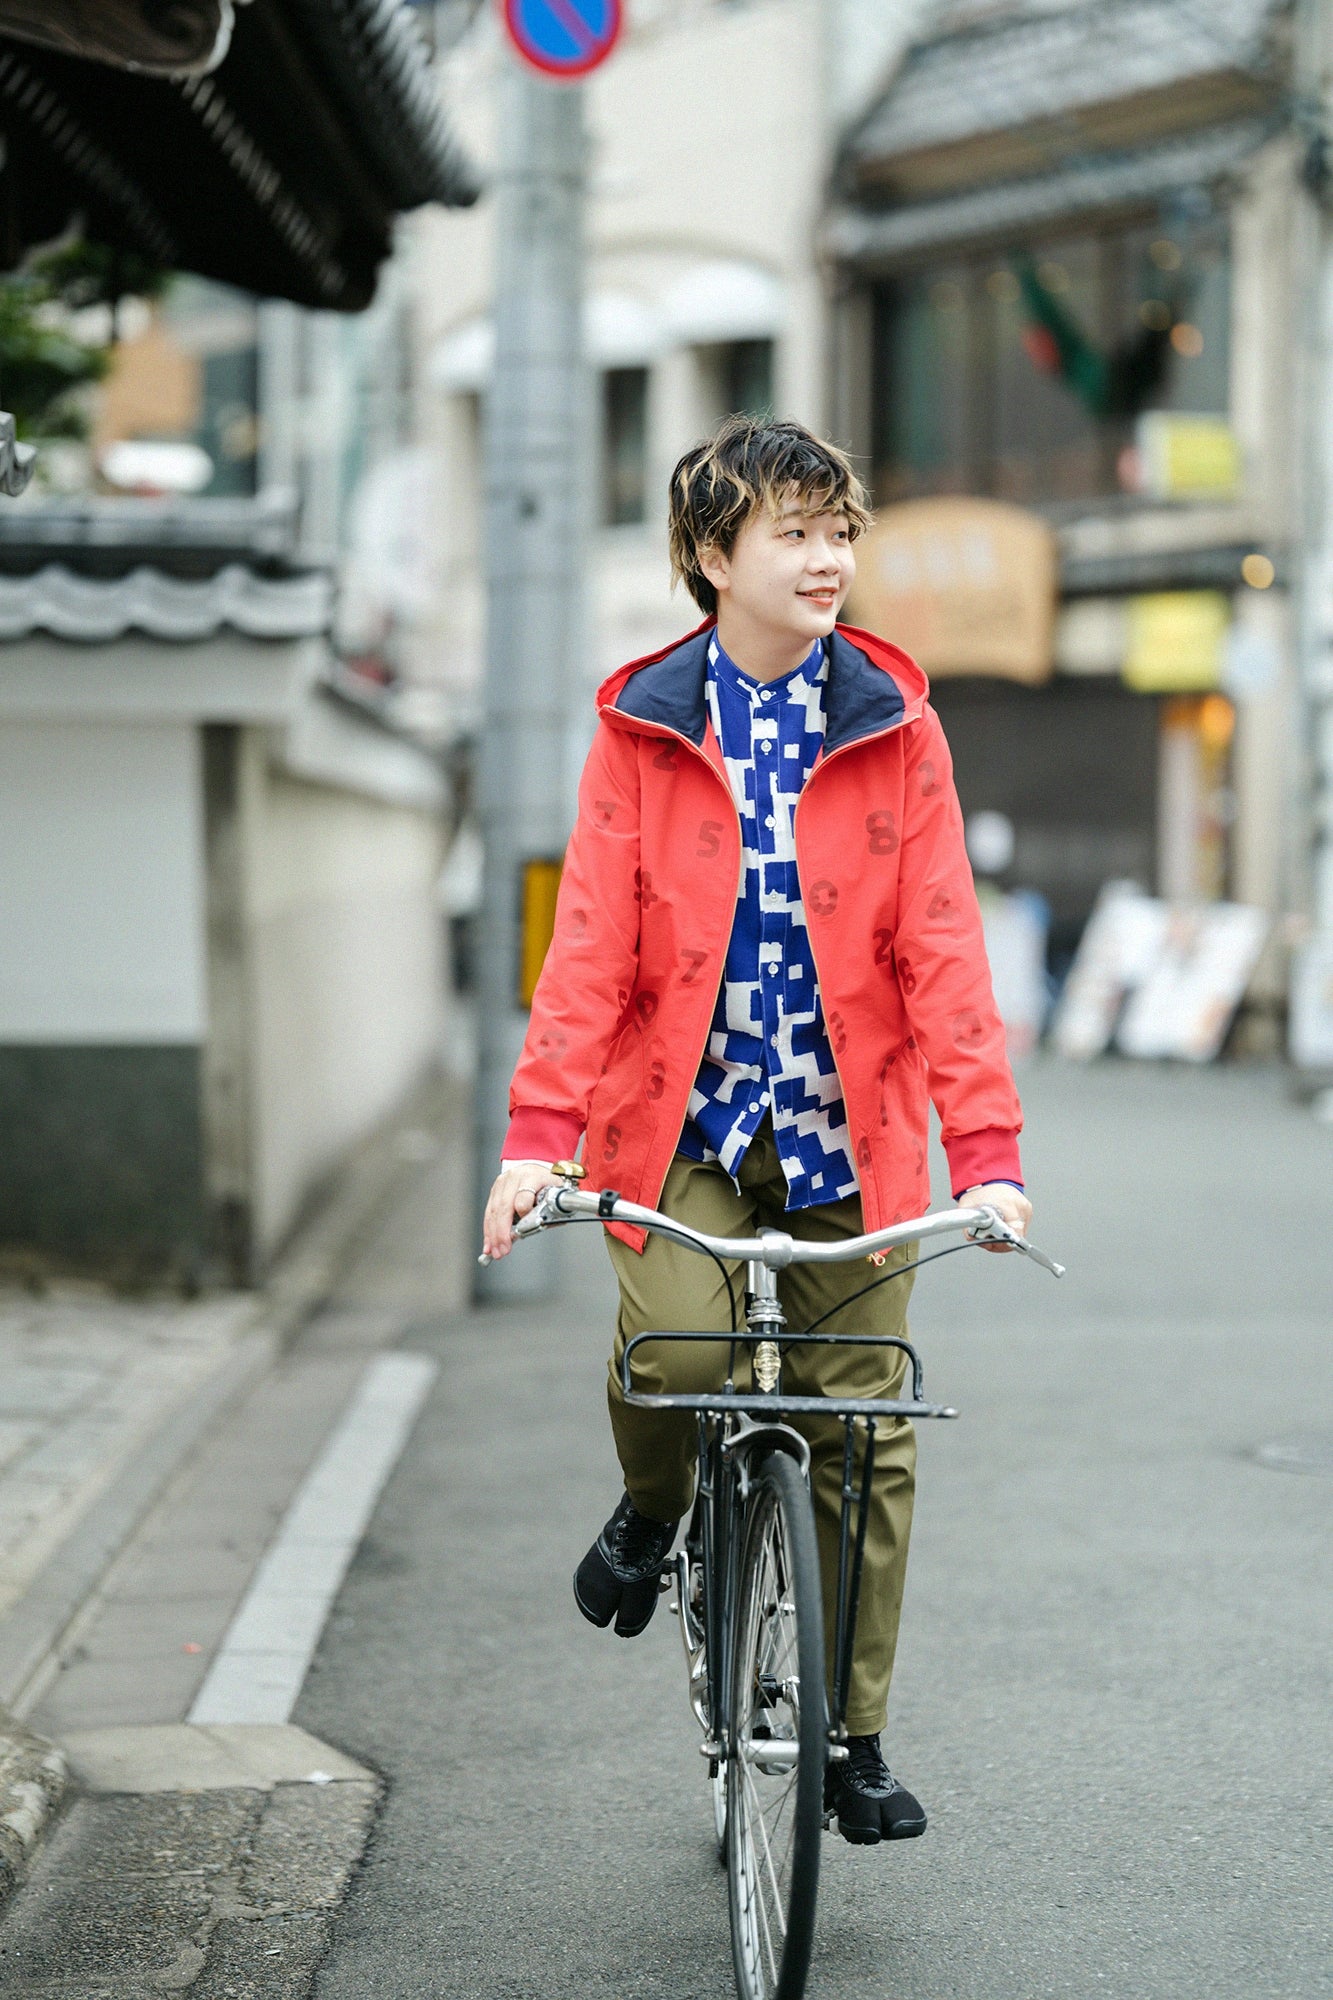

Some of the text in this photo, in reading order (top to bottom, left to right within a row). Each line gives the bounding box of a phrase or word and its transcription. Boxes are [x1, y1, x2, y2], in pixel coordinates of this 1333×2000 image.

[652, 737, 678, 772] 2
[917, 759, 942, 797] 2
[695, 820, 724, 859] 5
[865, 810, 899, 856] 8
[808, 880, 838, 916] 0
[925, 886, 960, 925] 4
[681, 949, 708, 983] 7
[872, 928, 894, 967] 2
[897, 957, 917, 996] 6
[603, 1124, 622, 1162] 5
